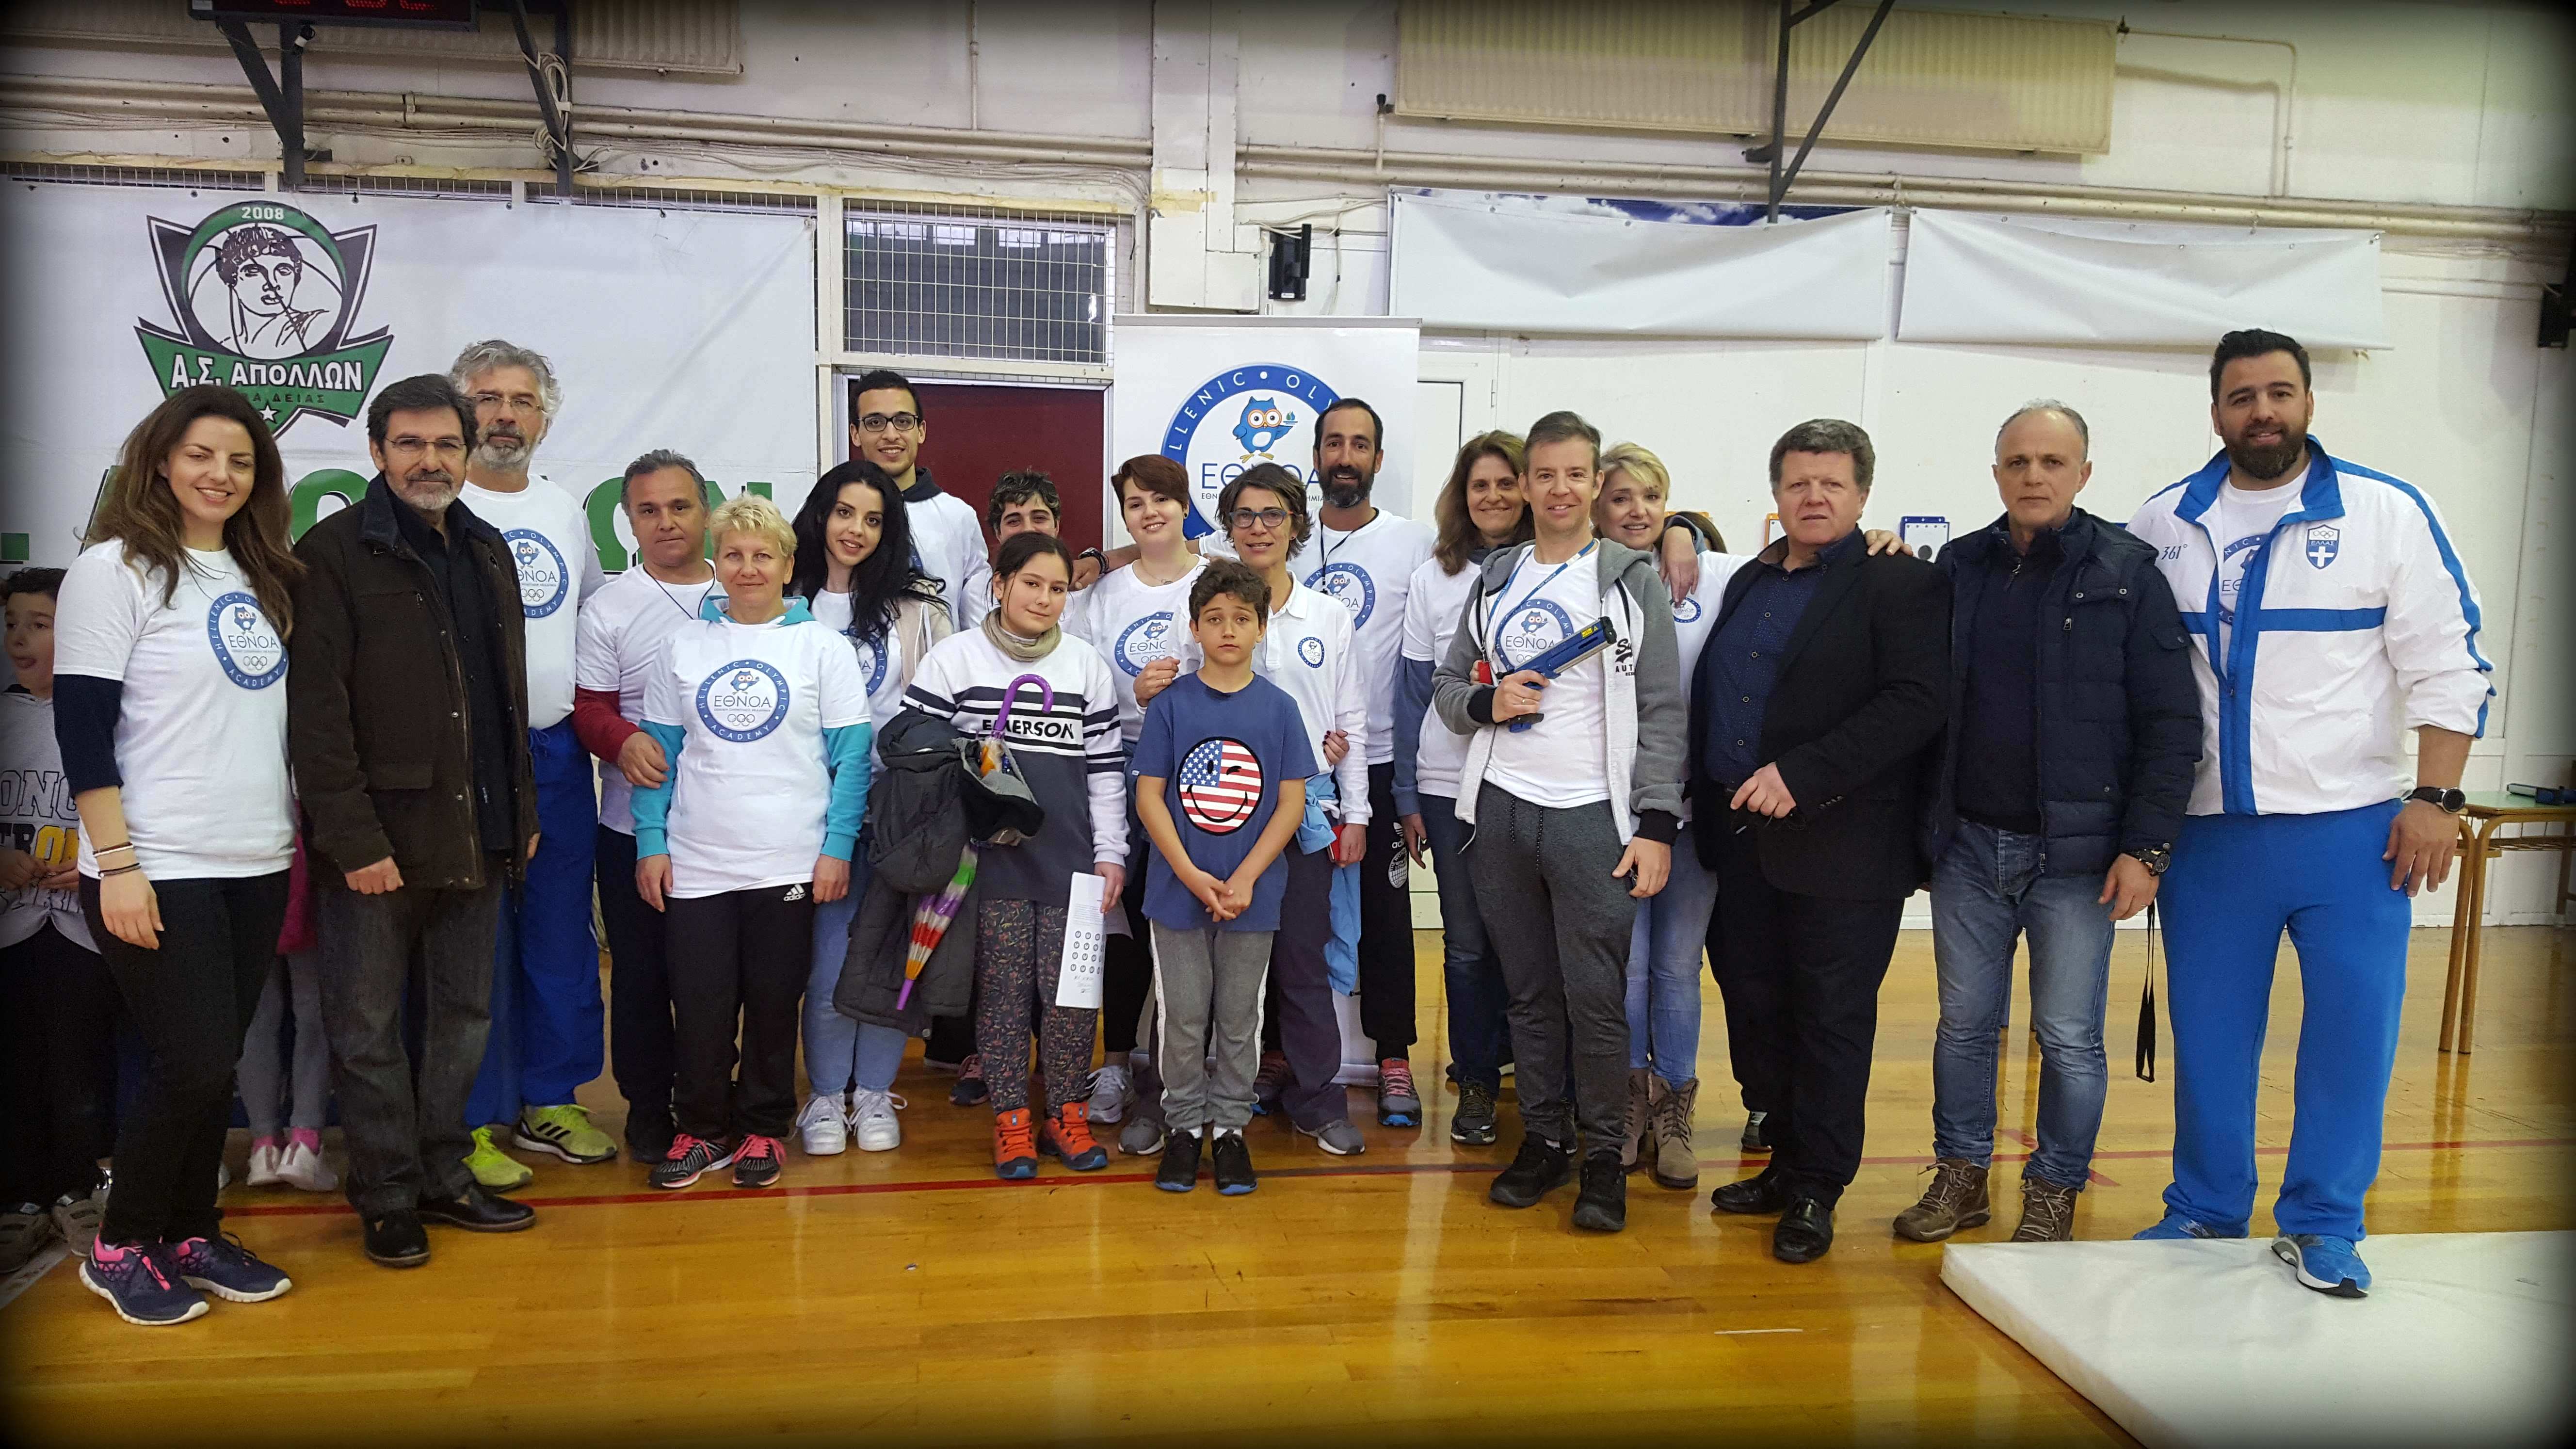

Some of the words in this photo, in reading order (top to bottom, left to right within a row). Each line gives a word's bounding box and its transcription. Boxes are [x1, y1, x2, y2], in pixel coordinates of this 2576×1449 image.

[242, 206, 284, 220] 2008
[171, 354, 222, 387] Α.Σ.
[231, 362, 363, 391] ΑΠΟΛΛΩΝ
[252, 392, 325, 403] ΑΔΕΙΑΣ
[1168, 372, 1245, 451] LLENIC
[531, 532, 567, 584] OLYMPIC
[1348, 565, 1372, 610] OLYMPIC
[209, 596, 232, 650] HELLENIC
[524, 600, 557, 615] DEMY
[1546, 603, 1573, 637] OLYMP
[1117, 616, 1151, 655] HELLENIC
[229, 669, 279, 686] ACADEMY
[698, 661, 740, 708] HELLENIC
[757, 663, 788, 710] OLYMPIC
[711, 724, 770, 740] ACADEMY
